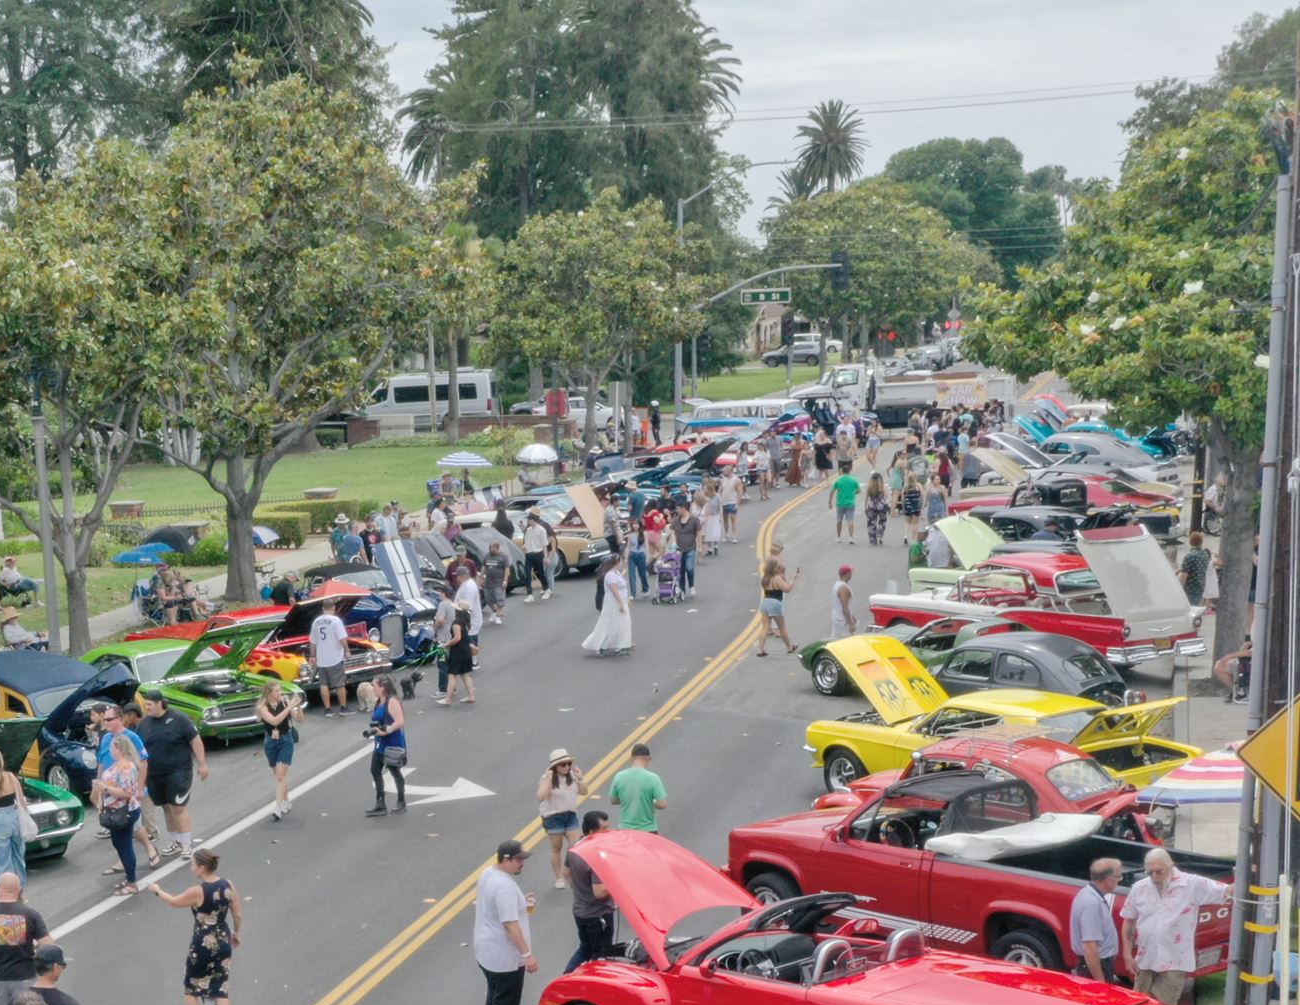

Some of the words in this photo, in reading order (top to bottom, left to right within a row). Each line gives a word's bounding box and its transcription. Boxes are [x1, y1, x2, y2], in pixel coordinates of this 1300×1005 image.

[771, 292, 780, 300] St
[950, 384, 973, 394] CAR
[319, 626, 327, 641] 5
